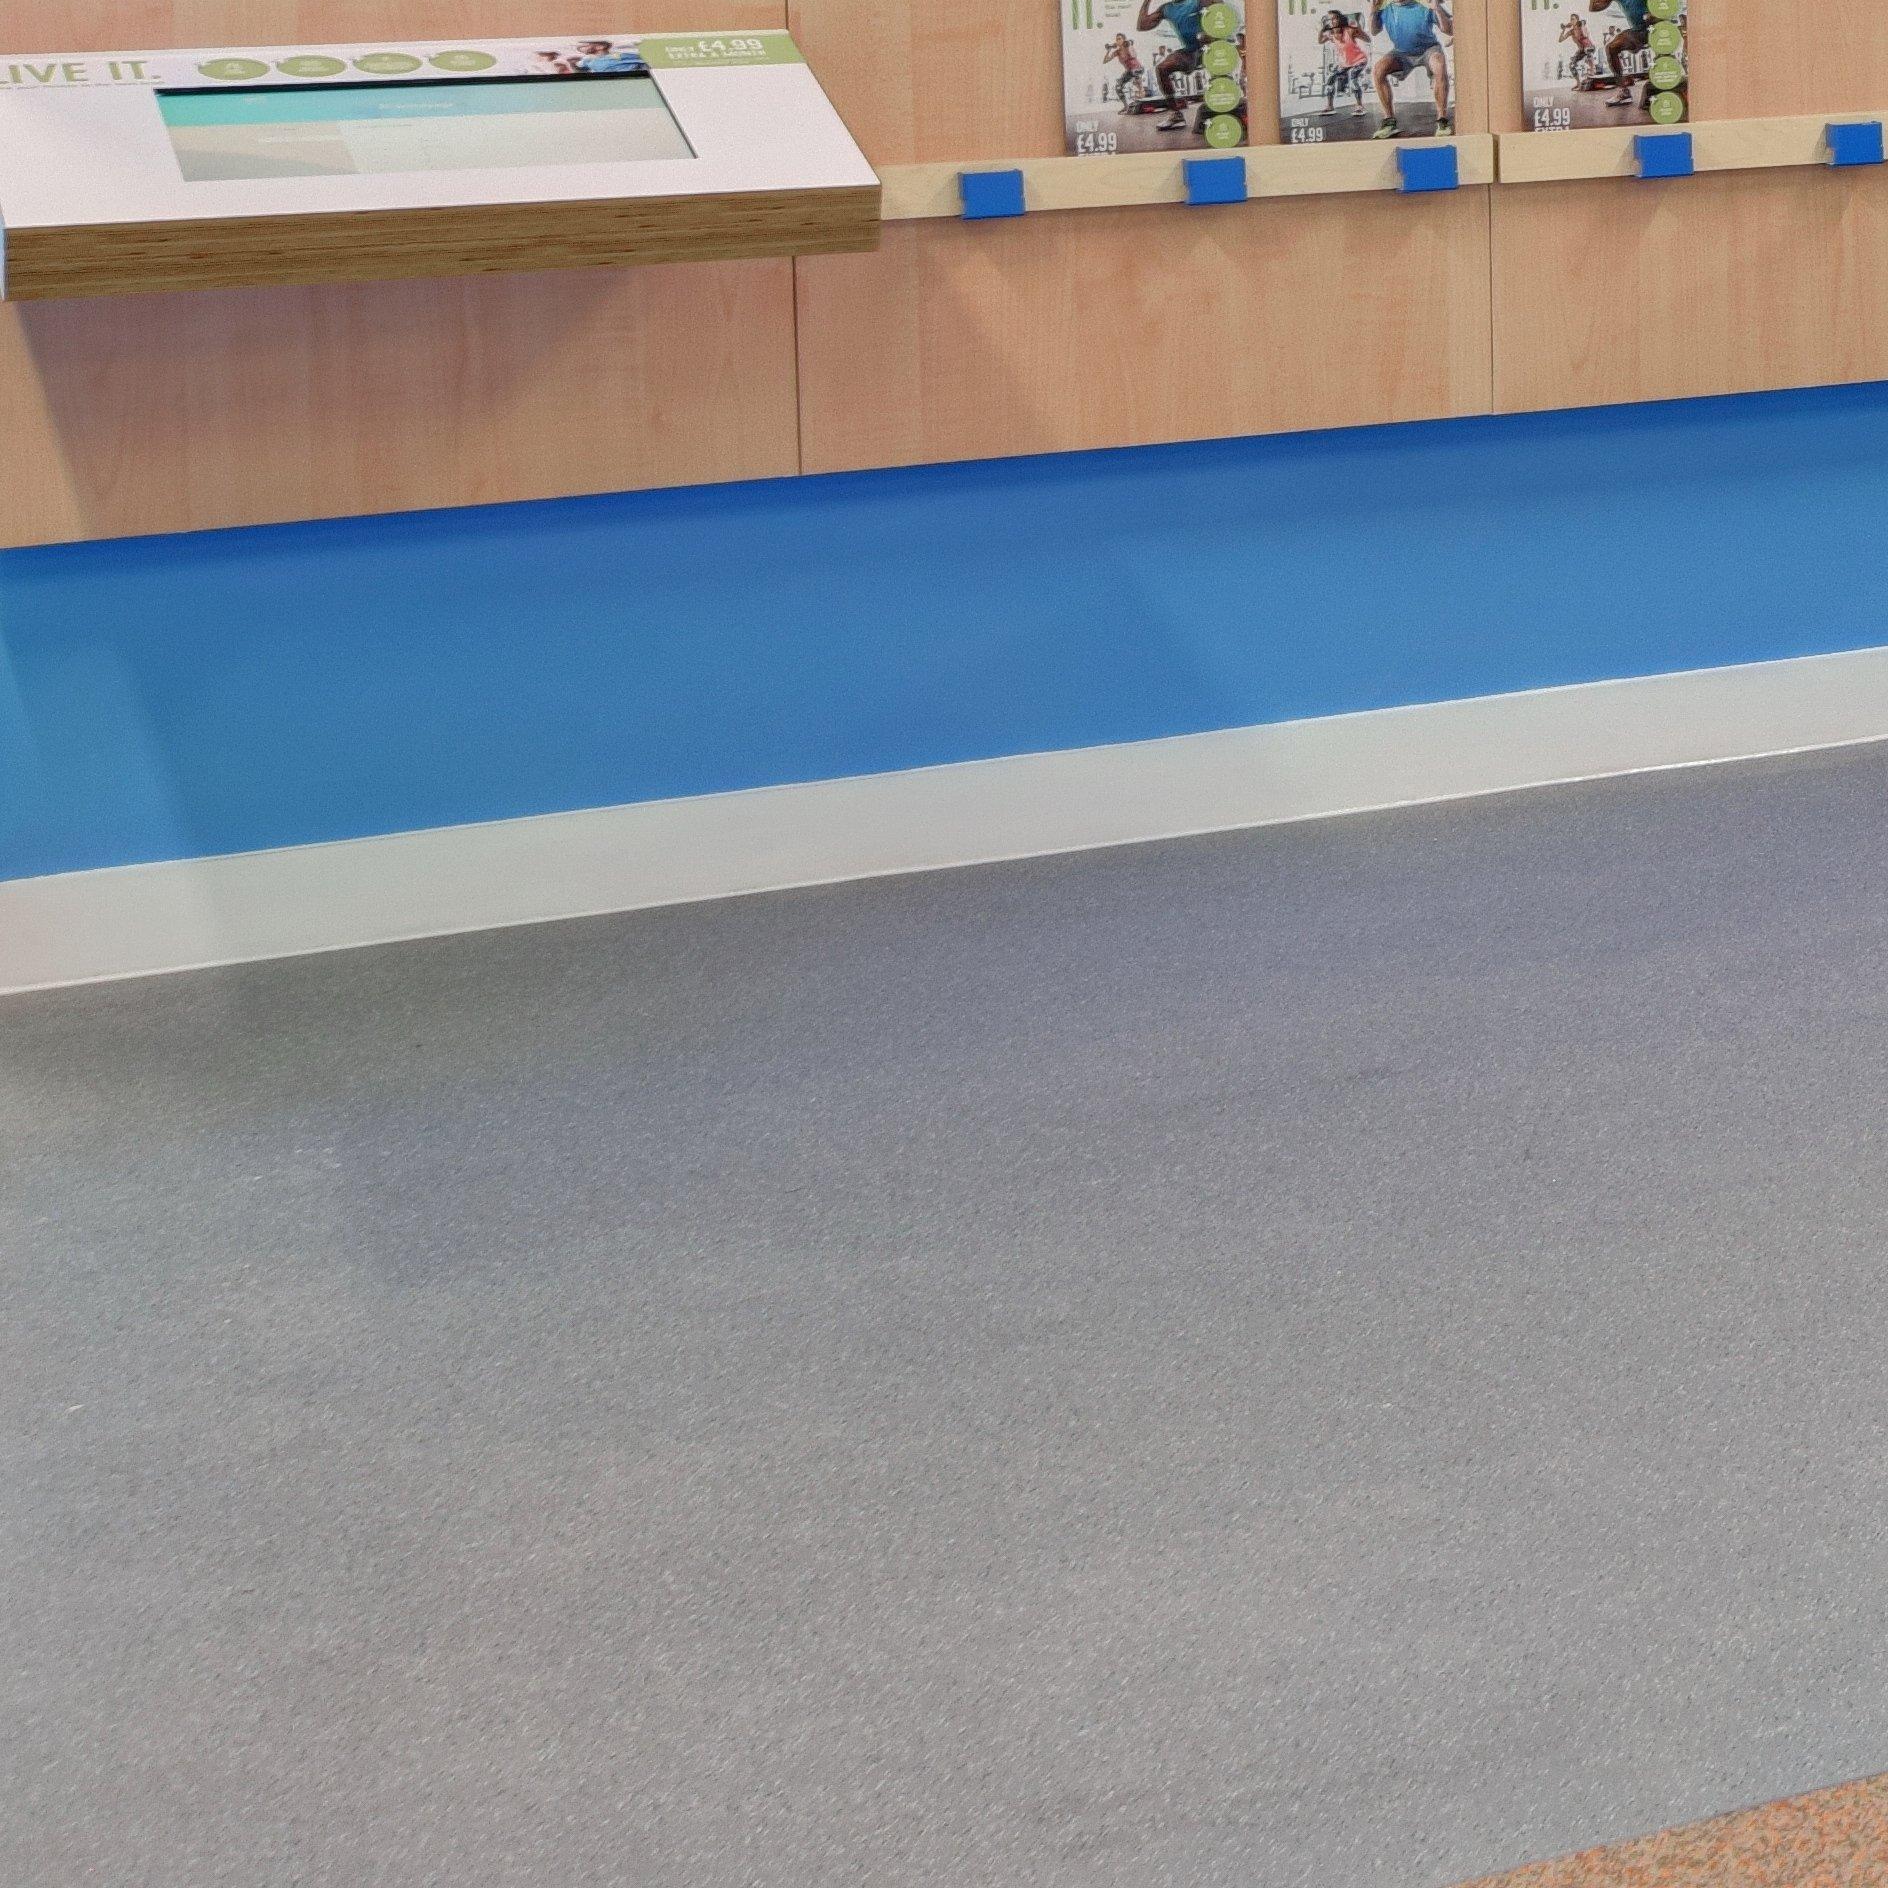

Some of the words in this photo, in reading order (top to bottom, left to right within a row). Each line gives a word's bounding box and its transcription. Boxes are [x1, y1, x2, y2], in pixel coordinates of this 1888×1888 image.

[108, 61, 161, 80] IT.
[1534, 107, 1571, 127] £4.99
[1077, 133, 1117, 152] £4.99
[1290, 127, 1325, 143] £4.99
